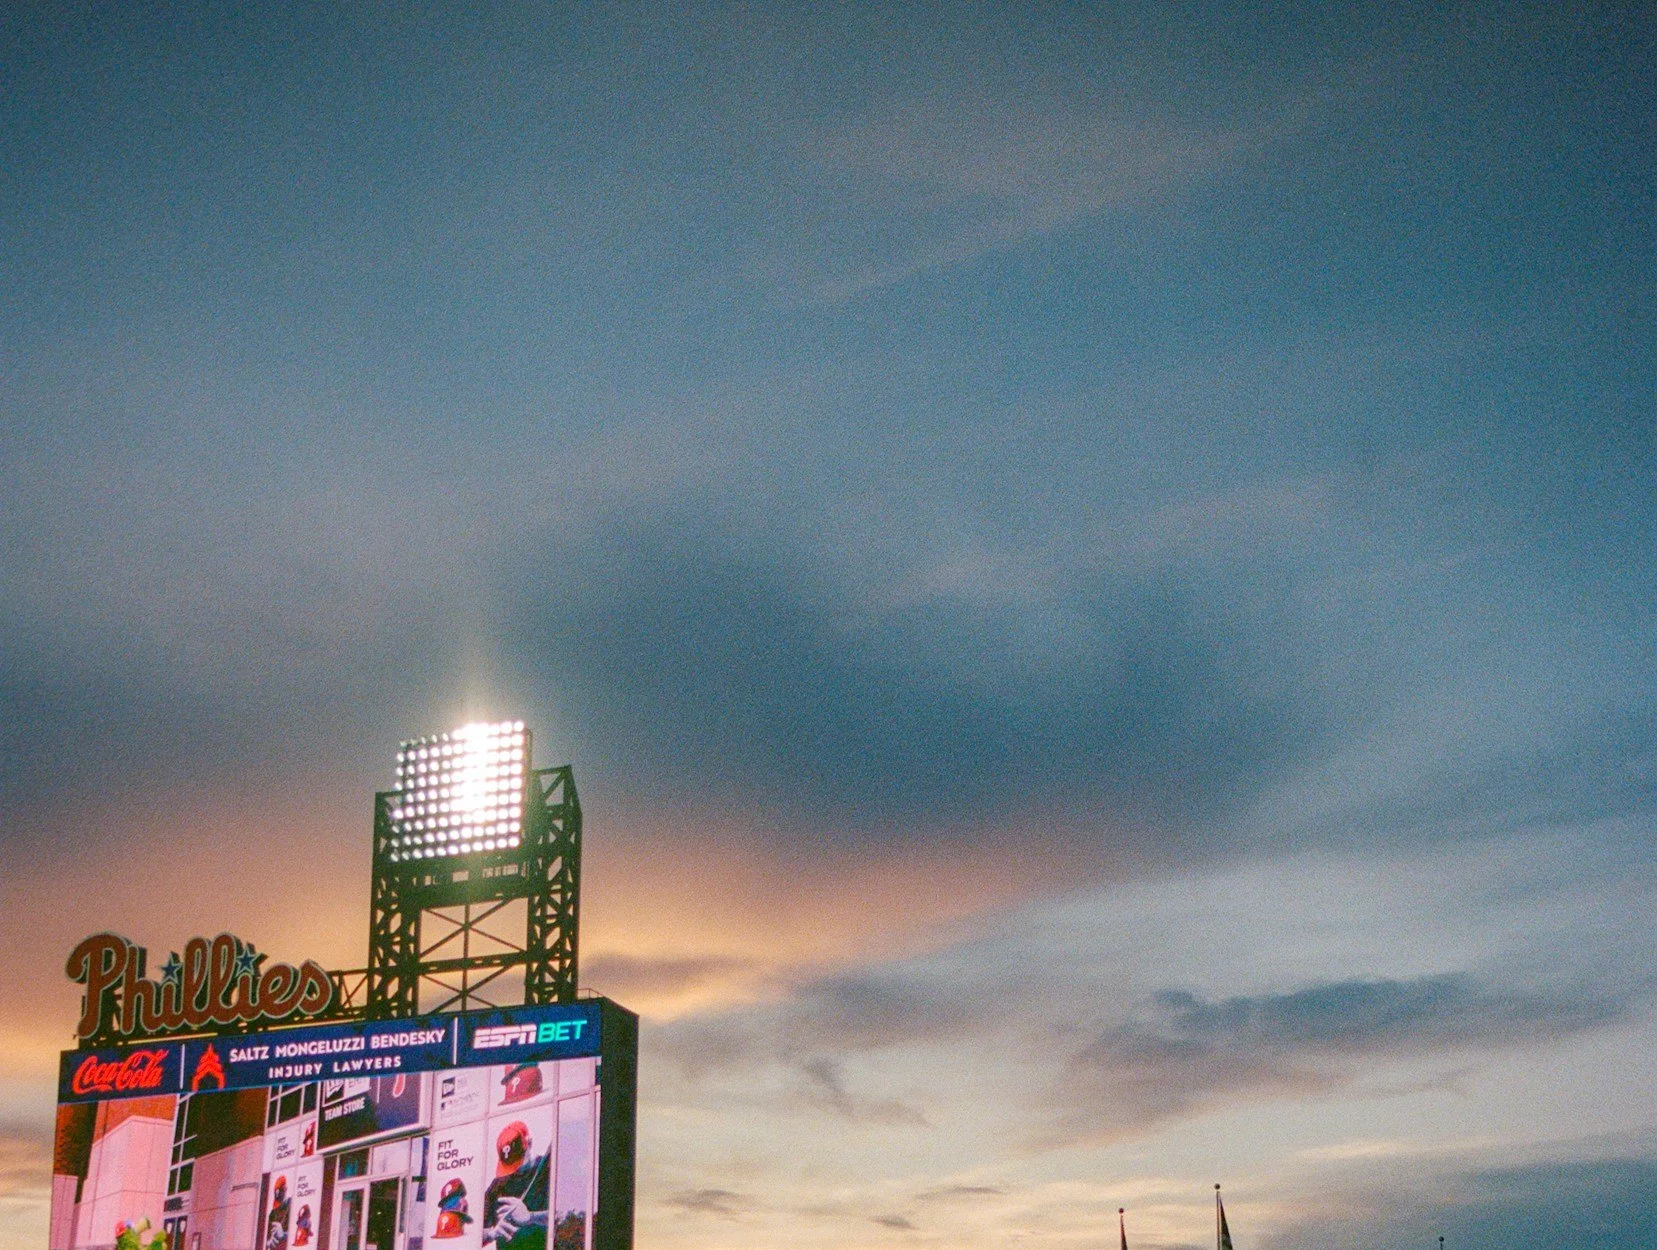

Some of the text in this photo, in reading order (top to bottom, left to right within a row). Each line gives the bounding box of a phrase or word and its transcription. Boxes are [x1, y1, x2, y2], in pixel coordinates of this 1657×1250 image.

[65, 930, 333, 1039] Phillies
[473, 1020, 588, 1049] ESPN BET
[230, 1030, 446, 1063] SALTZ MONGELUZZI BENDESKY
[268, 1056, 402, 1079] INJURY LAWYERS
[437, 1149, 459, 1160] FOR
[438, 1140, 454, 1150] FIT
[437, 1156, 474, 1171] GLORY
